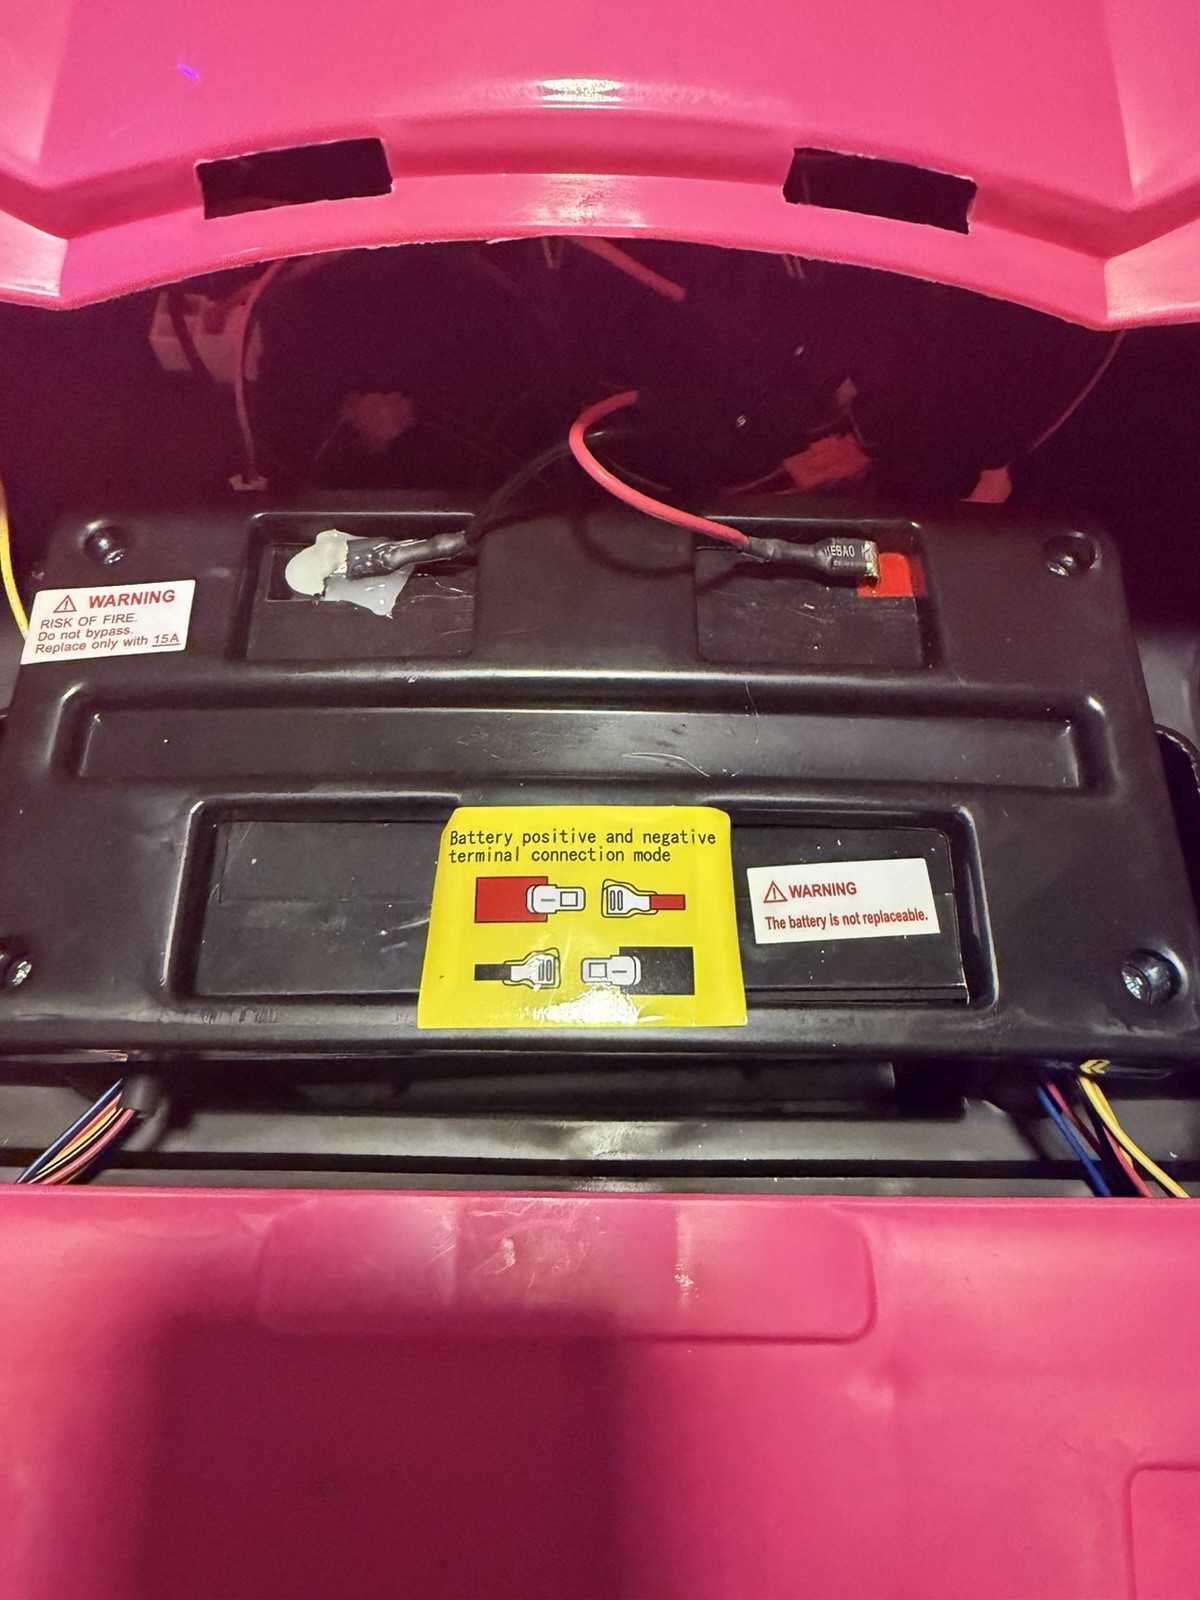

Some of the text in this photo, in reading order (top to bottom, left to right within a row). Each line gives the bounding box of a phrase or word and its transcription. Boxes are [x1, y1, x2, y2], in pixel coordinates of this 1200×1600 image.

[89, 589, 176, 609] WARNING
[40, 618, 73, 630] RISK
[78, 615, 98, 627] OF
[37, 626, 133, 642] Do not bypass.
[35, 633, 181, 655] Replace only with 15A
[450, 828, 717, 847] Battery positive and negative
[449, 845, 671, 864] terminal connection mode
[788, 881, 858, 899] WARNING
[765, 907, 929, 931] The battery is not replaceable.
